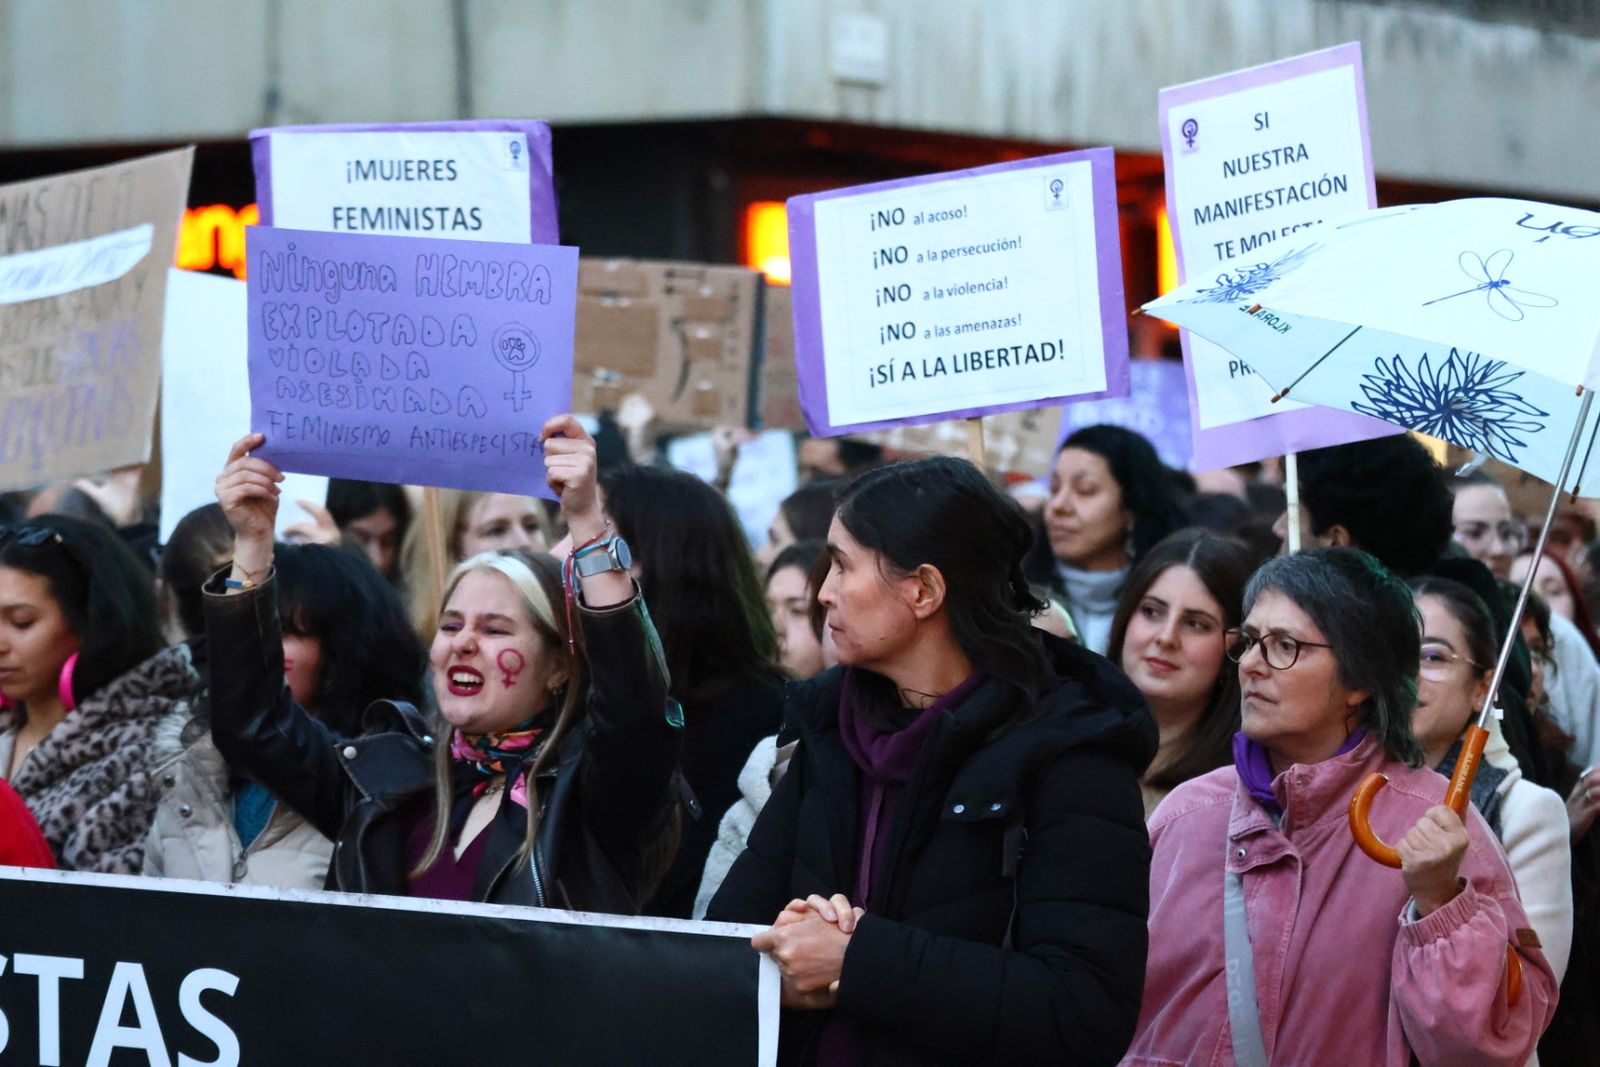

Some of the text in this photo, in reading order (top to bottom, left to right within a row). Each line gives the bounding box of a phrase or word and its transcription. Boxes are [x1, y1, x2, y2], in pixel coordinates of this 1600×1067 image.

[1253, 111, 1270, 131] SI
[346, 158, 458, 184] ¡MUJERES
[1222, 143, 1310, 179] NUESTRA
[1193, 173, 1348, 227] MANIFESTACIÓN
[332, 206, 483, 231] FEMINISTAS
[870, 204, 968, 232] ¡NO al acoso!
[873, 235, 1023, 270] ¡NO a la persecución!
[1213, 240, 1236, 261] TE
[415, 252, 552, 305] HEMBRA
[876, 275, 1009, 307] ¡NO a la violencia!
[262, 301, 478, 348] EXPLOTADA
[880, 313, 1023, 345] ¡NO a las amenazas!
[869, 338, 1065, 388] ¡SÍ A LA LIBERTAD!
[267, 409, 391, 447] FEMINISMO
[0, 951, 241, 1067] TAS
